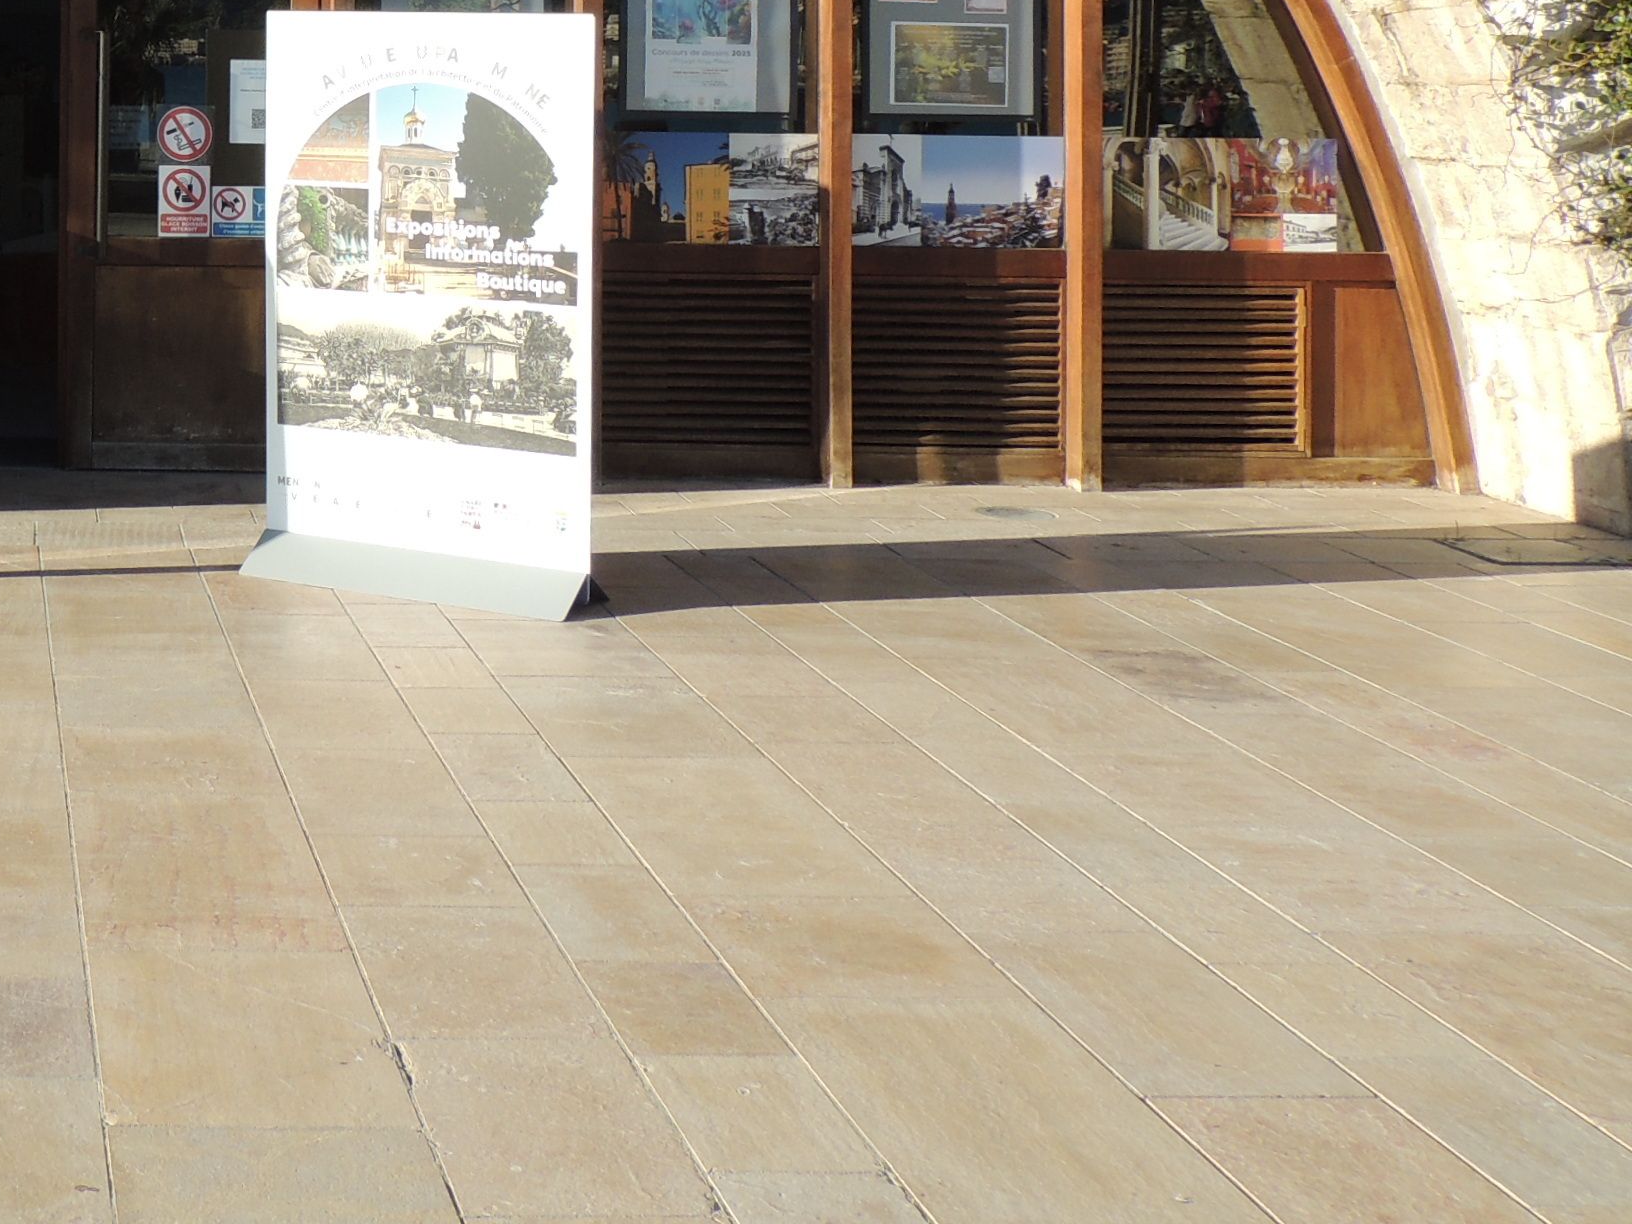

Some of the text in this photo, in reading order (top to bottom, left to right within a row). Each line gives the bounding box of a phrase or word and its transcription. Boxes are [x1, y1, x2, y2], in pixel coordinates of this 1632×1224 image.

[385, 216, 500, 240] Expositions
[425, 243, 554, 267] Informations
[476, 271, 566, 298] Boutique
